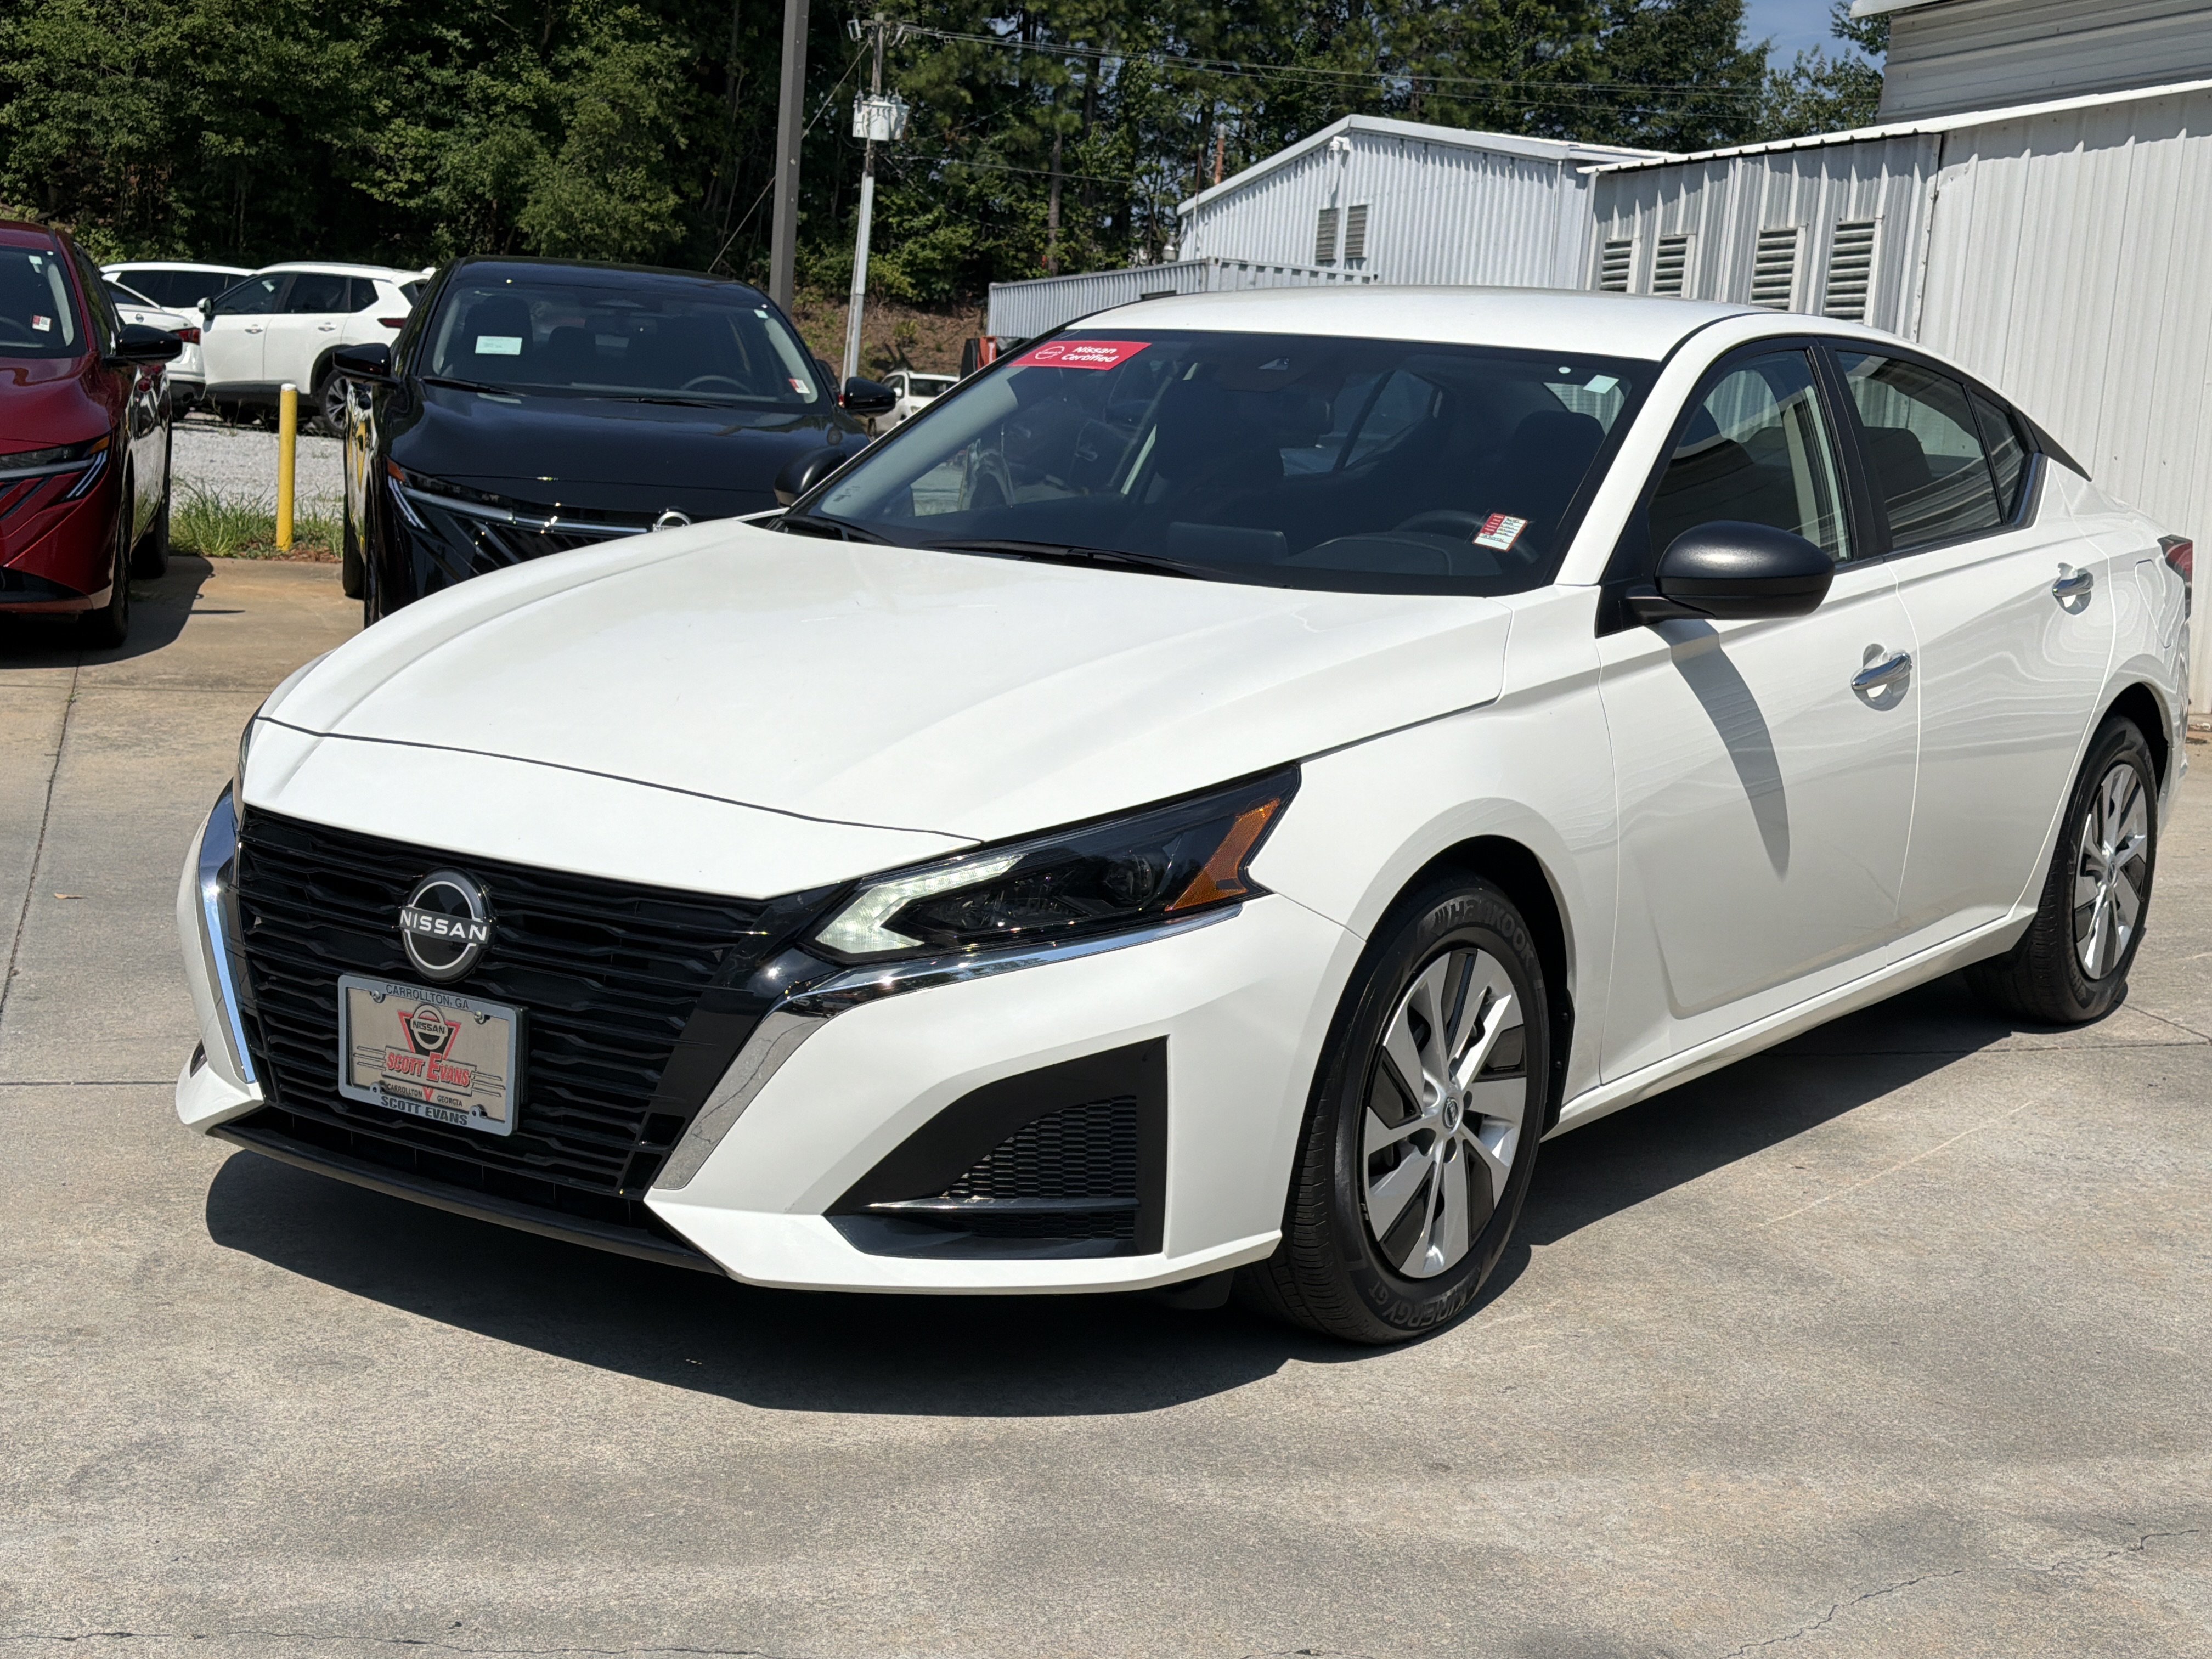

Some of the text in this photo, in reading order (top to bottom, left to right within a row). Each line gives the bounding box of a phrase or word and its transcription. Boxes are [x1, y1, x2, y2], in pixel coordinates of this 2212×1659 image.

[1061, 353, 1119, 362] Certified
[400, 909, 487, 941] NISSAN
[386, 984, 469, 1009] CARROLLTON, GA
[413, 1020, 445, 1035] NISSAN
[387, 1053, 425, 1077] SCOTT
[387, 1083, 463, 1107] CARROLLTON GEORGIA
[381, 1096, 468, 1125] SCOTT EVANS
